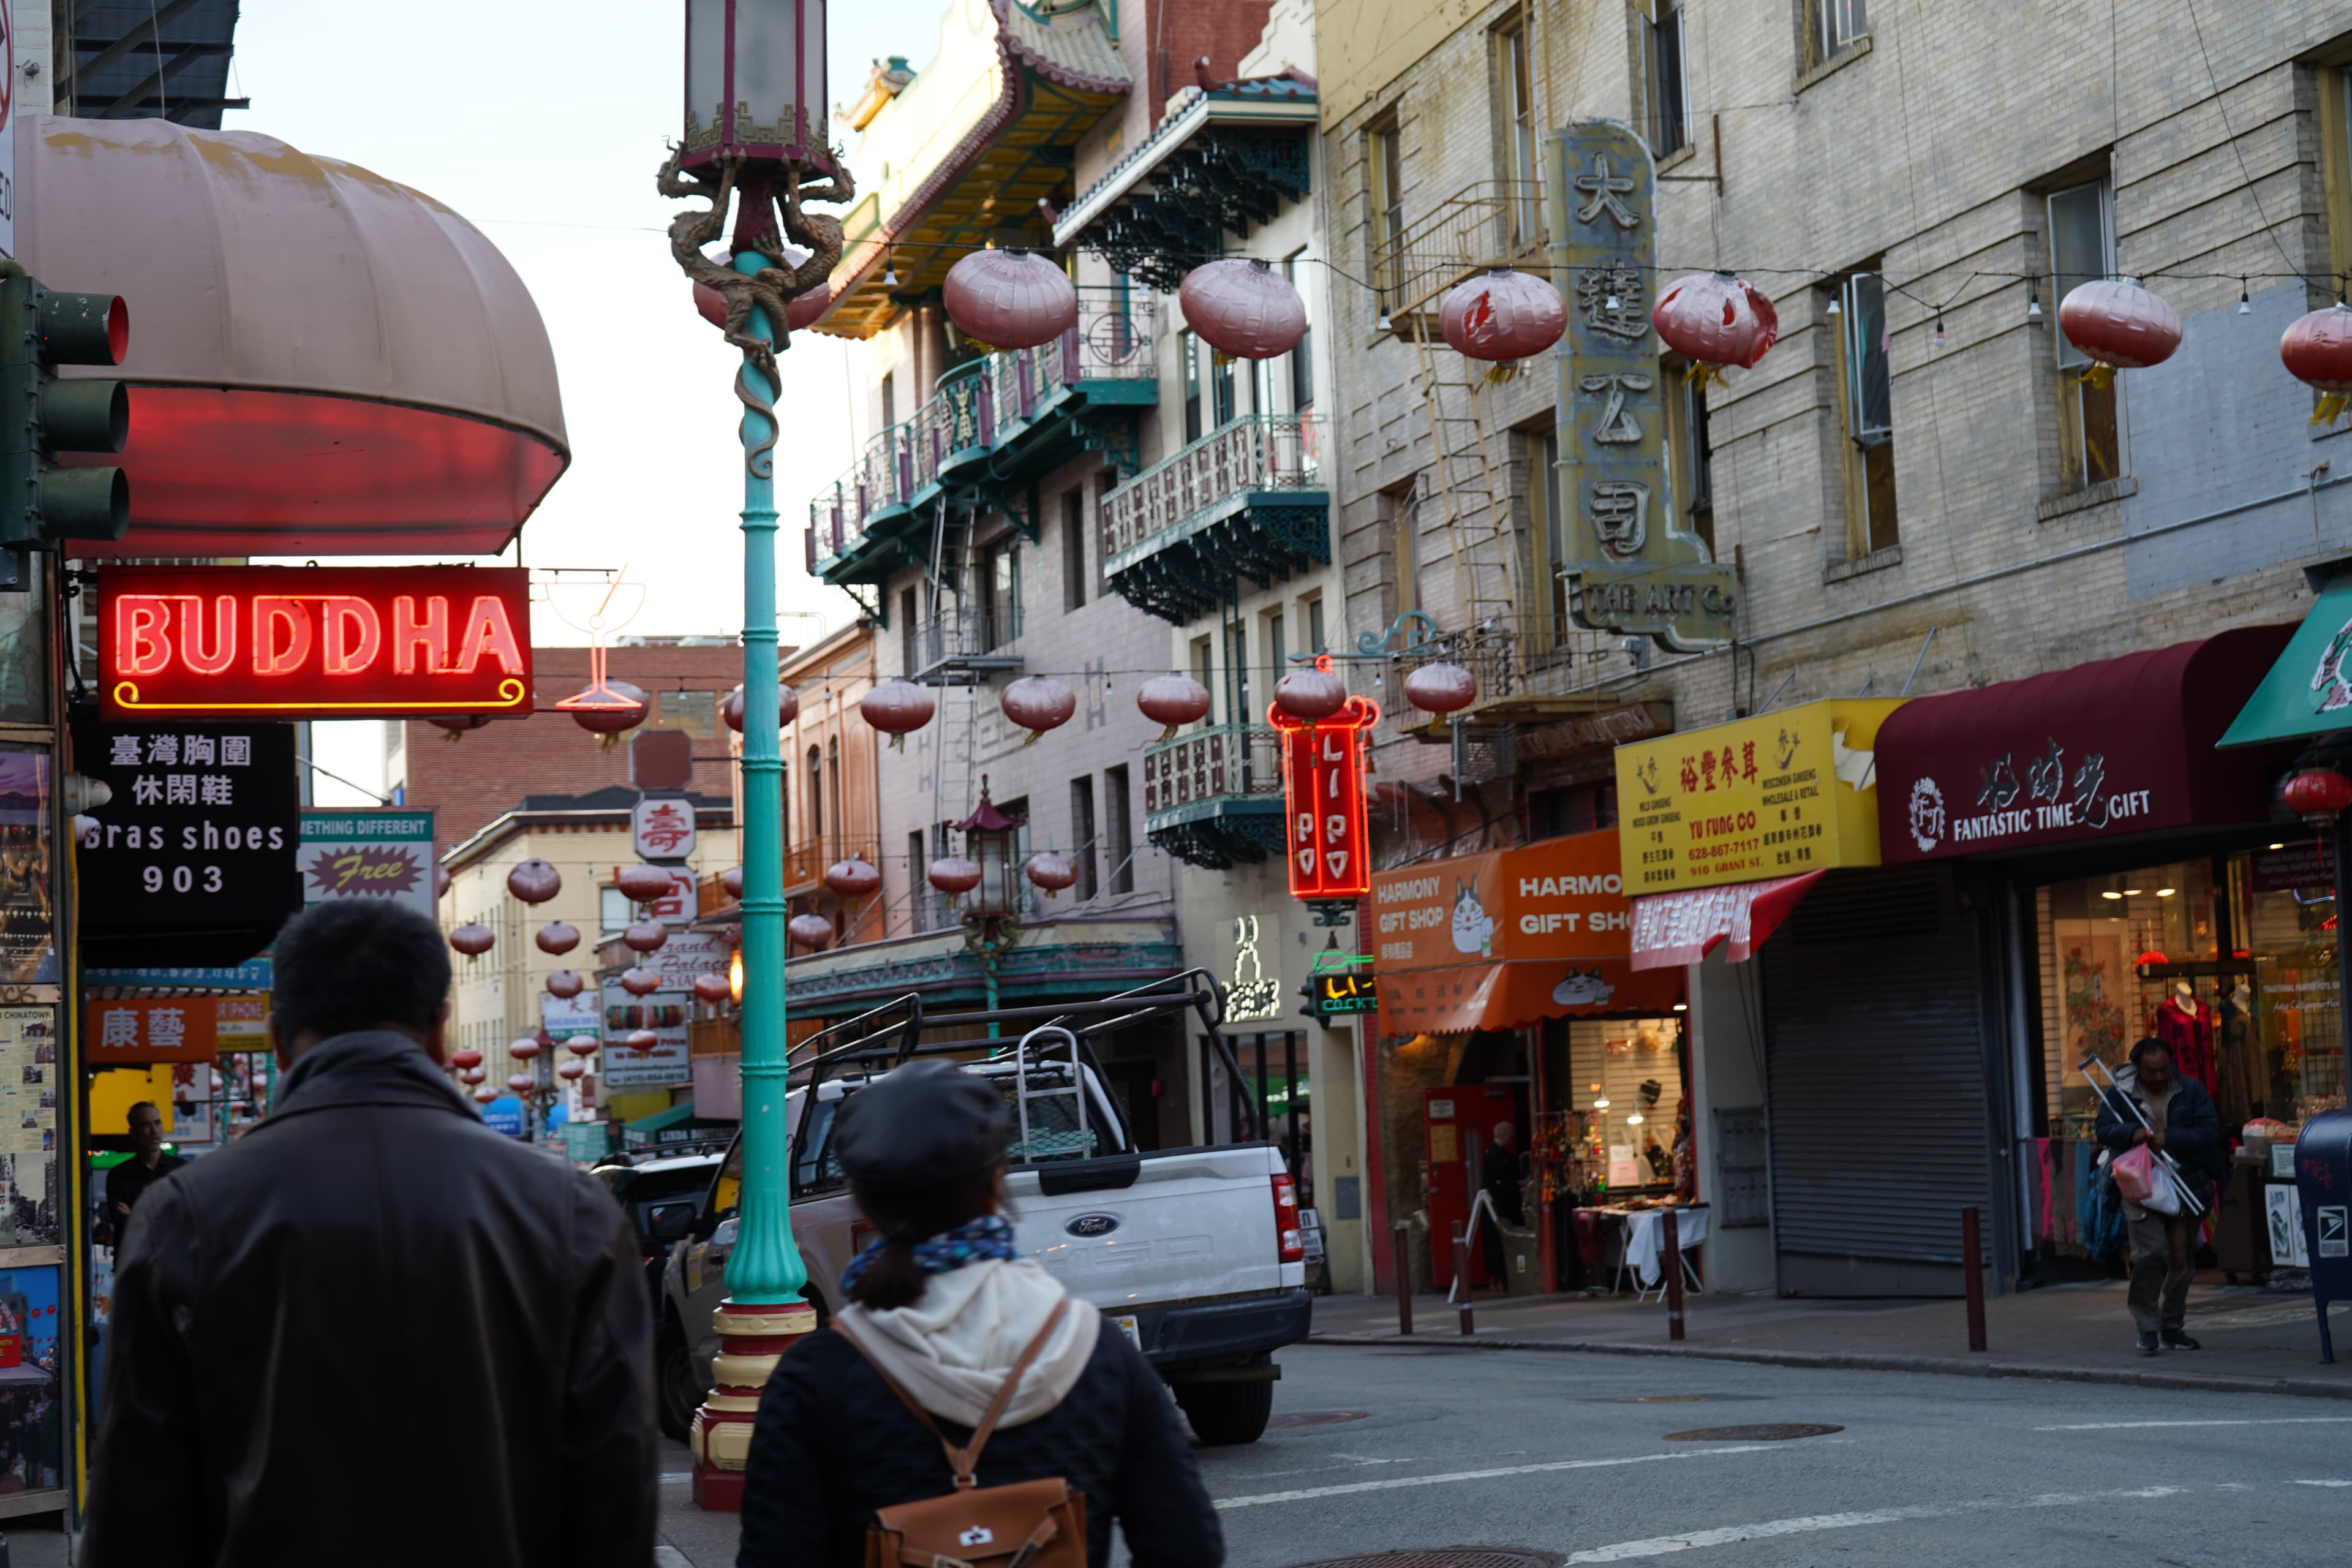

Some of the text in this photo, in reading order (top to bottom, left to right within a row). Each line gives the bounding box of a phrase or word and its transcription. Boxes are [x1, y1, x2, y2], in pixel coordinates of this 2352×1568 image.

[1587, 584, 1637, 612] THE
[1645, 584, 1695, 613] ART
[116, 594, 524, 676] BUDDHA
[110, 734, 251, 766] 臺灣胸圍
[1680, 740, 1758, 793] 裕豐參茸
[1763, 768, 1817, 789] WISCONSIN GINSENG
[132, 775, 233, 805] 休閑鞋
[1763, 790, 1793, 806] WHOLESALE
[1800, 785, 1819, 799] RETAIL
[2110, 790, 2150, 820] GIFT
[183, 820, 284, 850] shoes
[300, 820, 426, 835] METHING DIFFERENT
[1689, 810, 1755, 840] YU FUNG CO
[1954, 802, 2075, 842] FANTASTIC TIME
[1689, 838, 1758, 861] 628-867-7117
[143, 865, 222, 893] 903
[333, 854, 404, 889] Free
[1691, 865, 1709, 876] 910
[1715, 859, 1745, 873] GRANT
[1378, 876, 1440, 904] HARMONY
[1520, 874, 1623, 897] HARMO
[1380, 907, 1444, 933] GIFT SHOP
[1520, 911, 1630, 934] GIFT SH
[5, 1011, 51, 1020] CHINATOWN
[229, 1000, 263, 1017] IPHONE
[1322, 997, 1379, 1011] COCKT
[102, 1006, 185, 1047] 康藝
[1078, 1218, 1108, 1232] Ford
